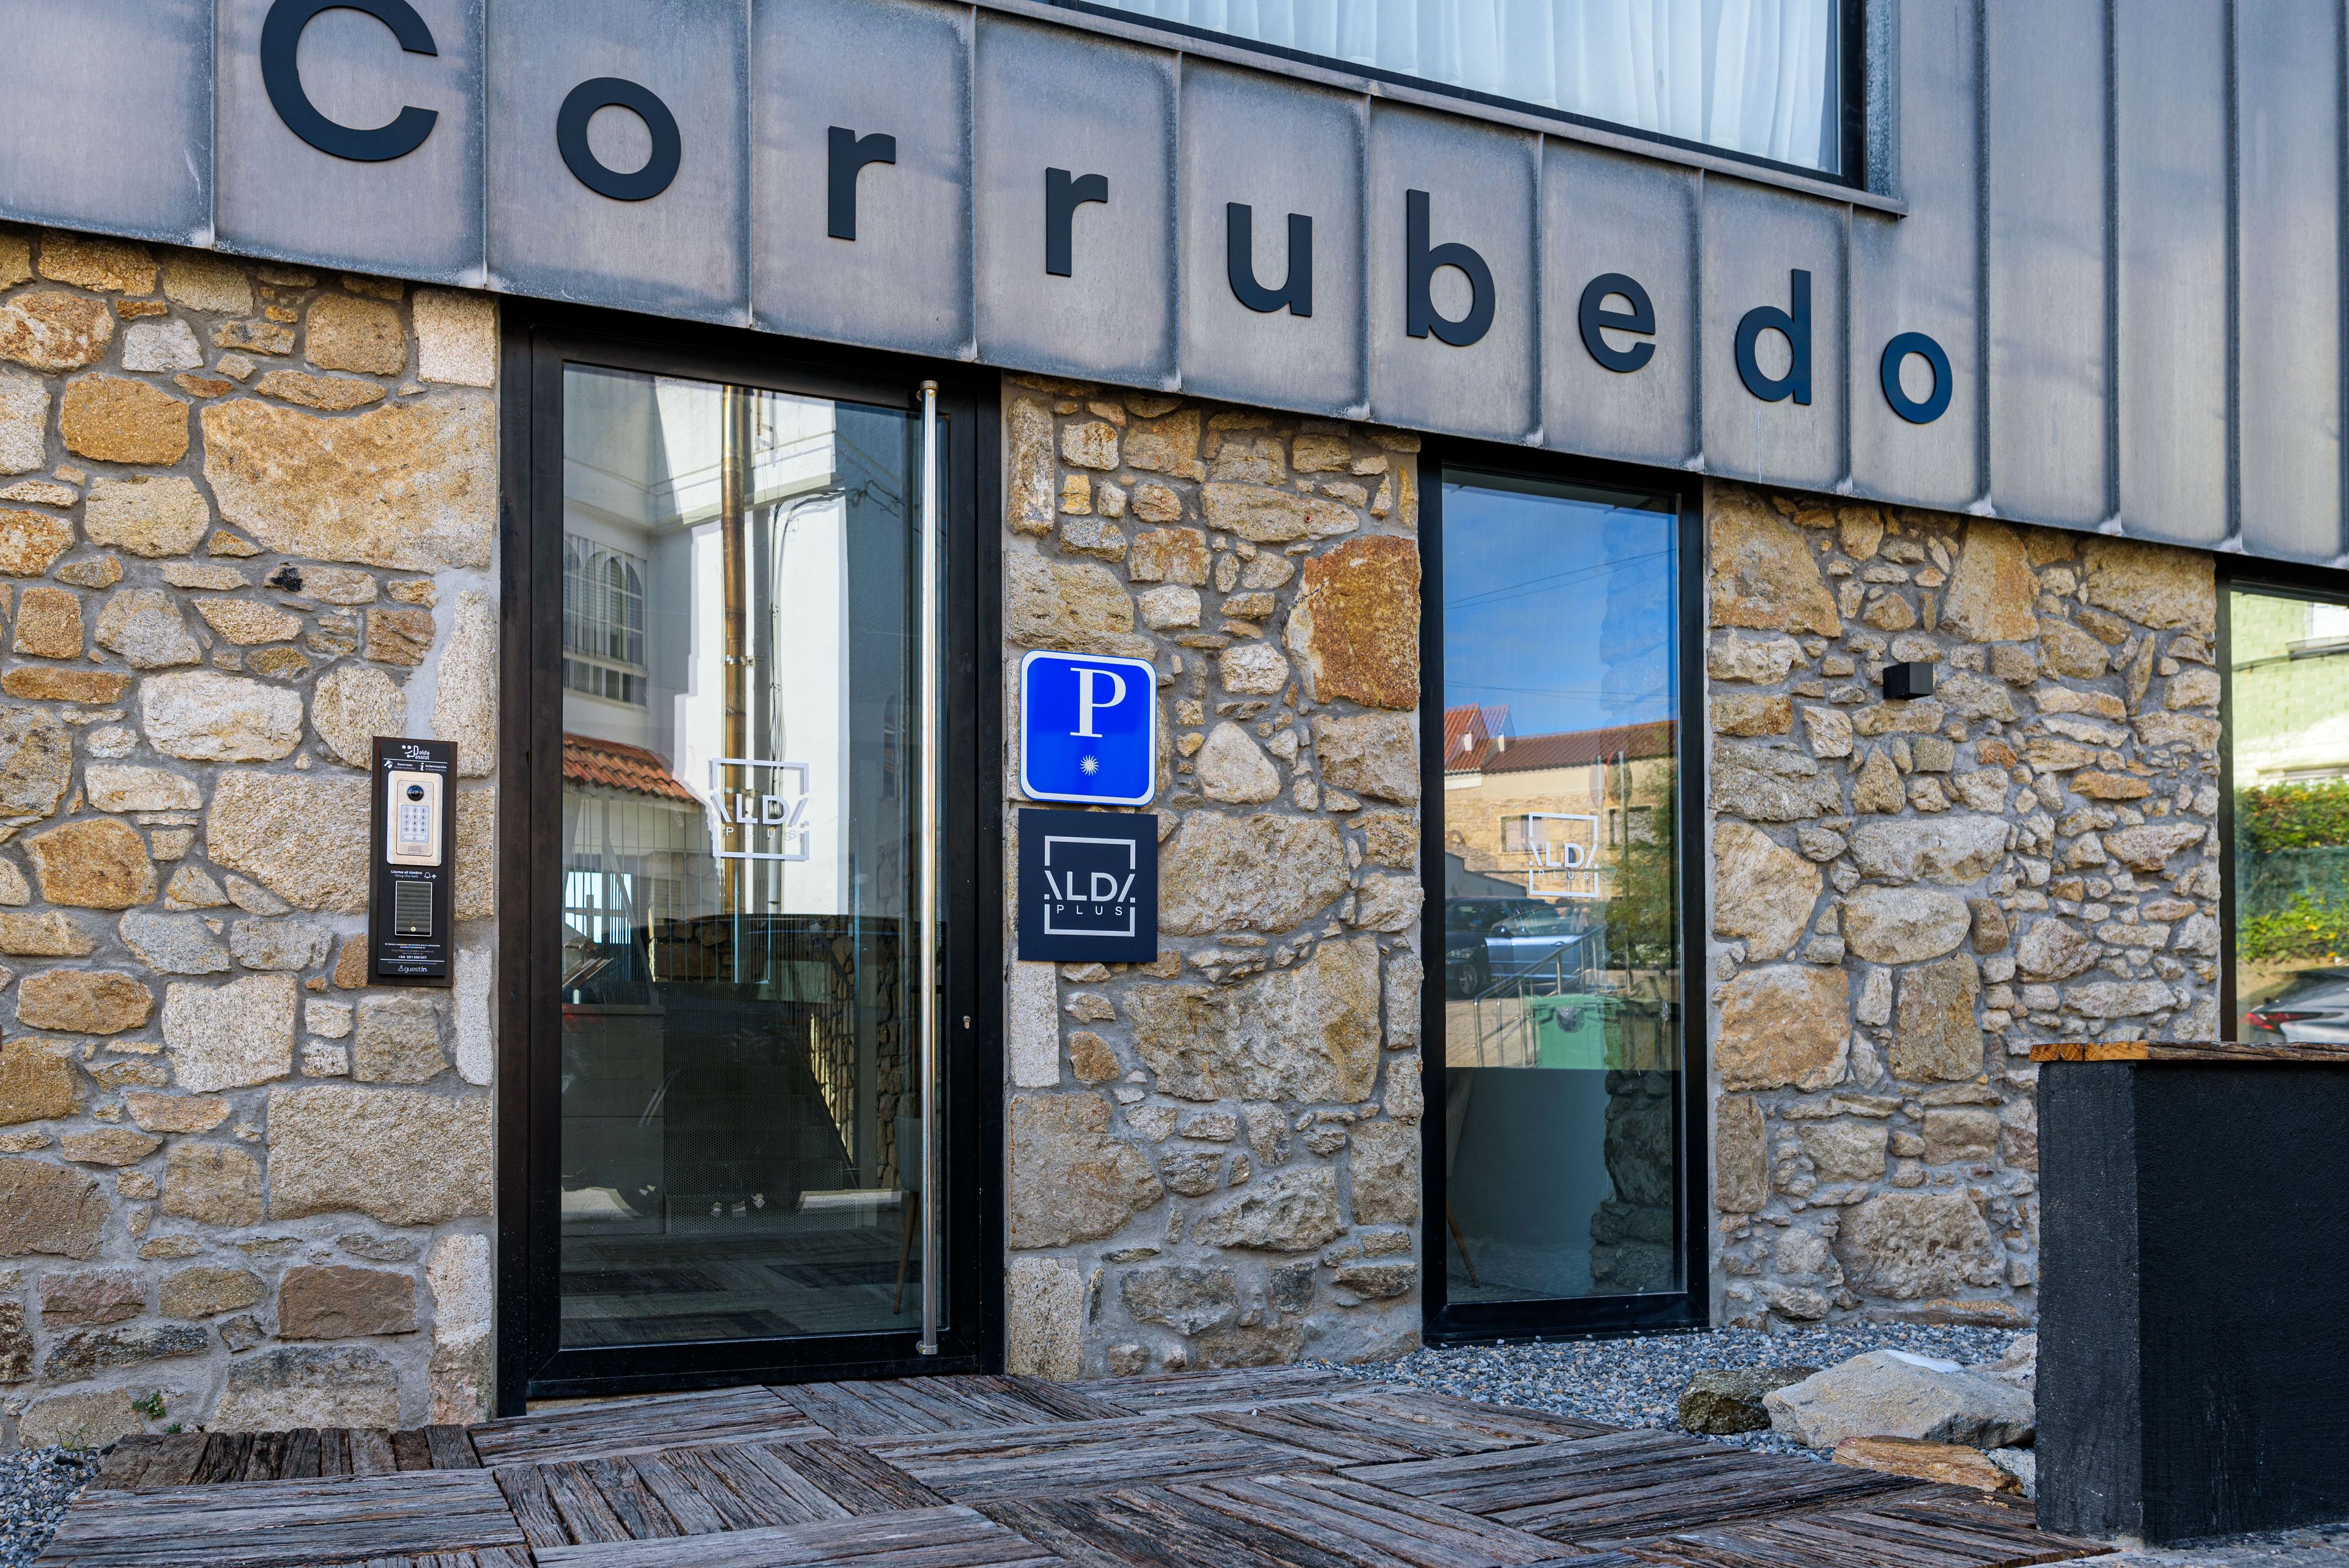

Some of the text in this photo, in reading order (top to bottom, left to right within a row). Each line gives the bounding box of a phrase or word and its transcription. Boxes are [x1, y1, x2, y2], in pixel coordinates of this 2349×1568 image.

[261, 0, 1953, 424] Corrubedo
[1070, 667, 1126, 738] P
[1539, 870, 1589, 879] PLUS
[1056, 904, 1123, 915] PLUS
